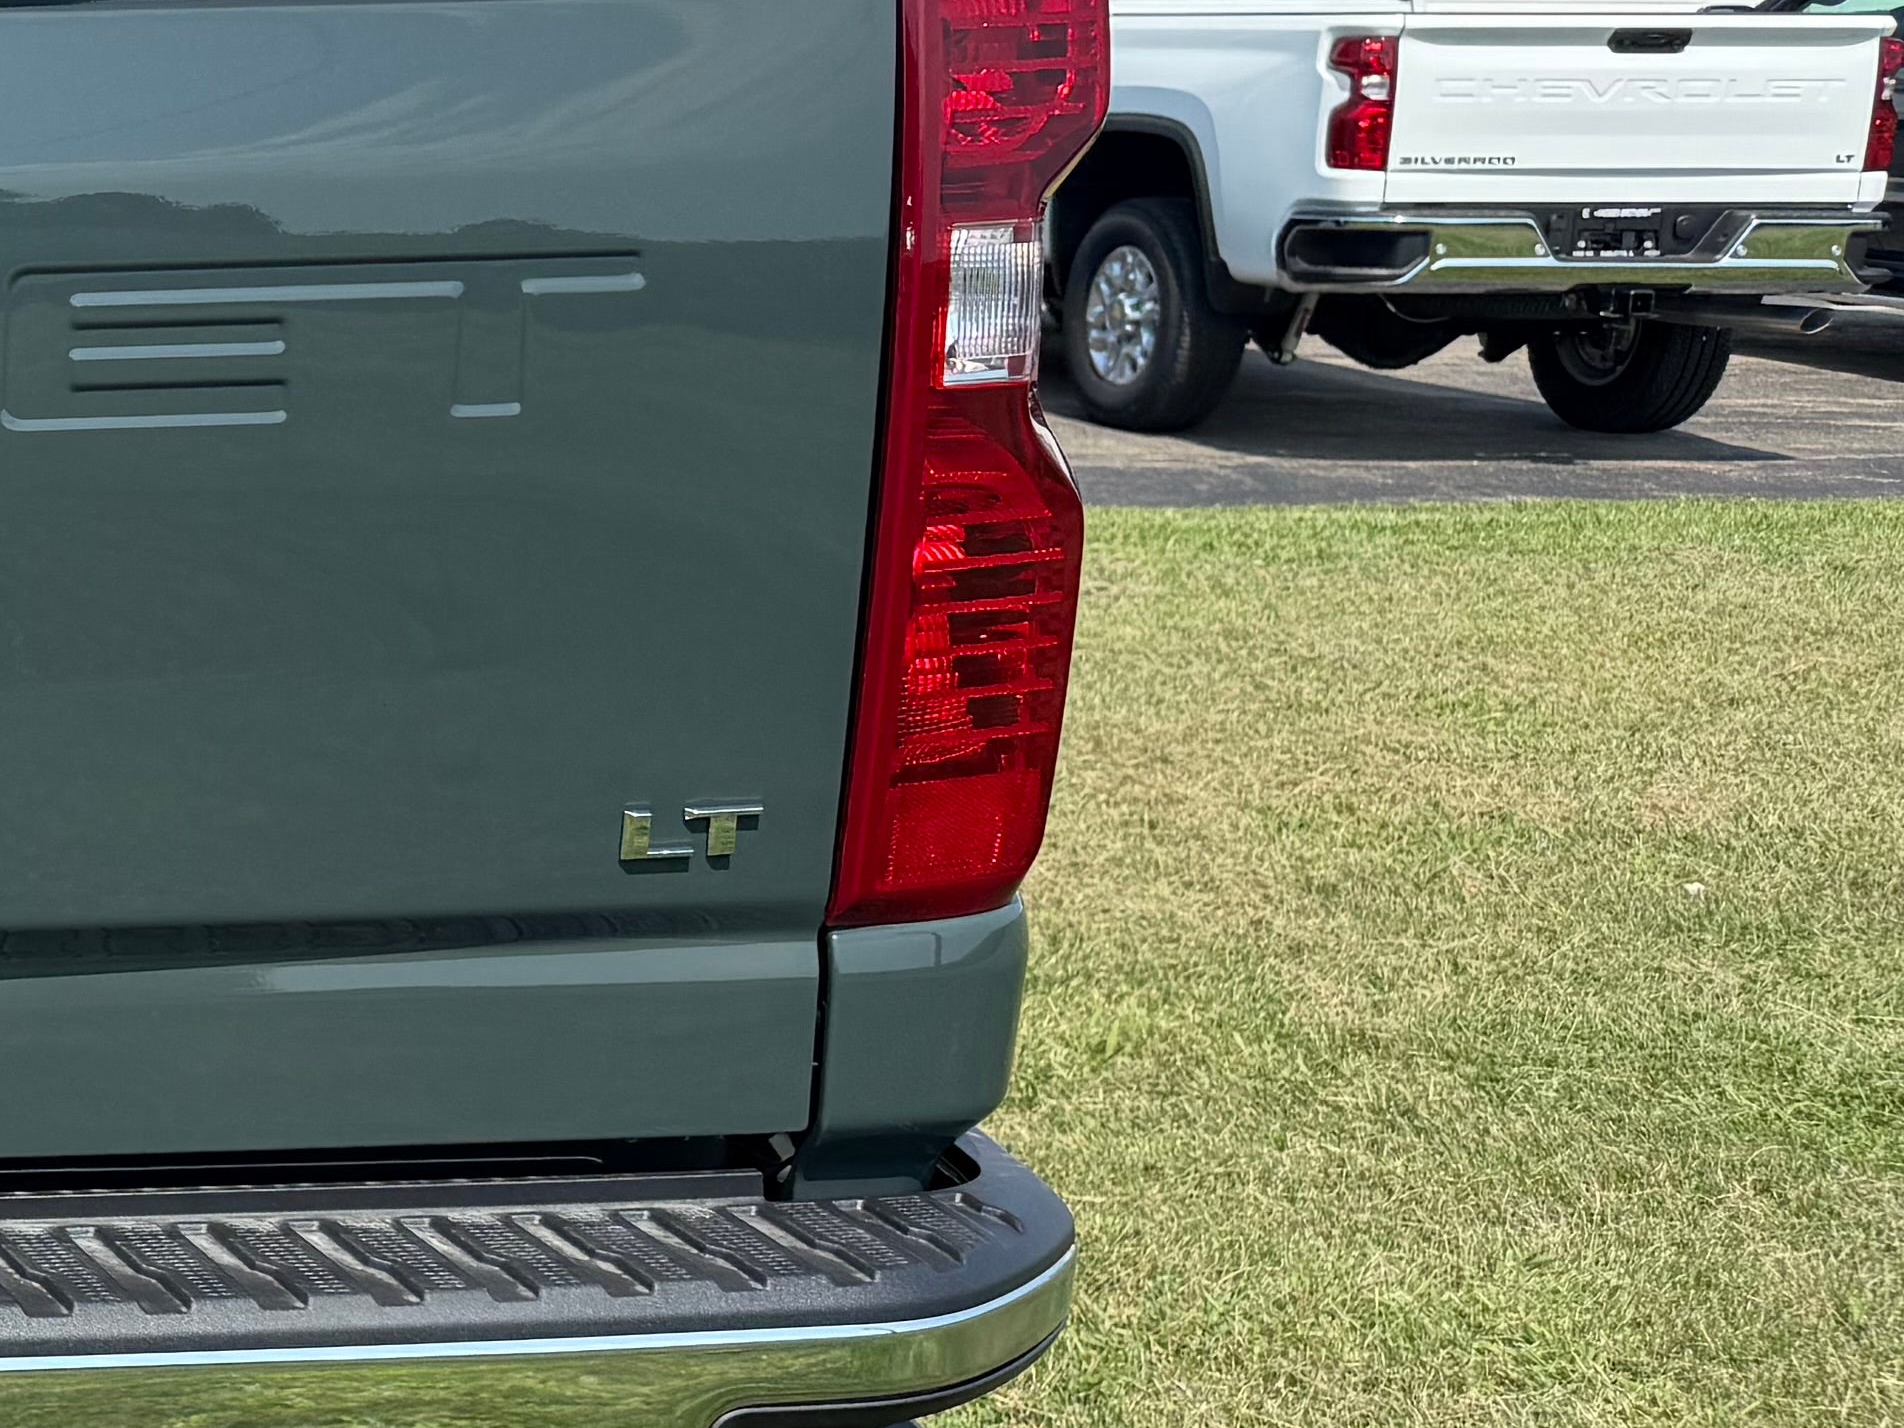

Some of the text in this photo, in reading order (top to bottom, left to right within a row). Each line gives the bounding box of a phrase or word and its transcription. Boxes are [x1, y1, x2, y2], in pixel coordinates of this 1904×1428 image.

[1437, 77, 1848, 103] CHEVROLET
[1835, 154, 1856, 164] LT
[620, 800, 763, 863] LT
